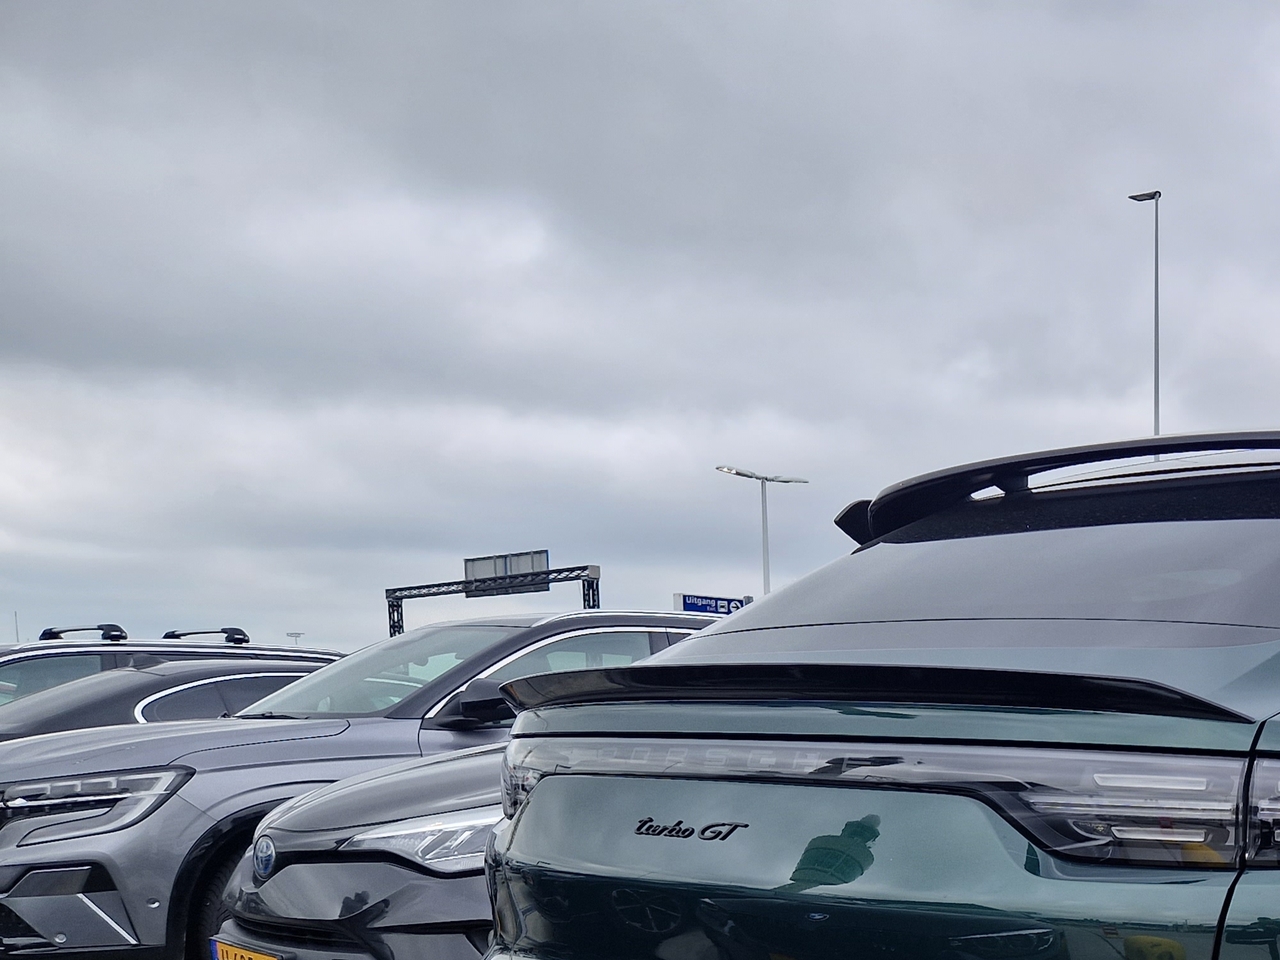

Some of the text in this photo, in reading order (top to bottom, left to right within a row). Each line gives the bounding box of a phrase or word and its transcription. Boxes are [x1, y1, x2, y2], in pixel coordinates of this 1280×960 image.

[685, 596, 716, 606] Uitgang
[635, 816, 750, 841] turbo GT
